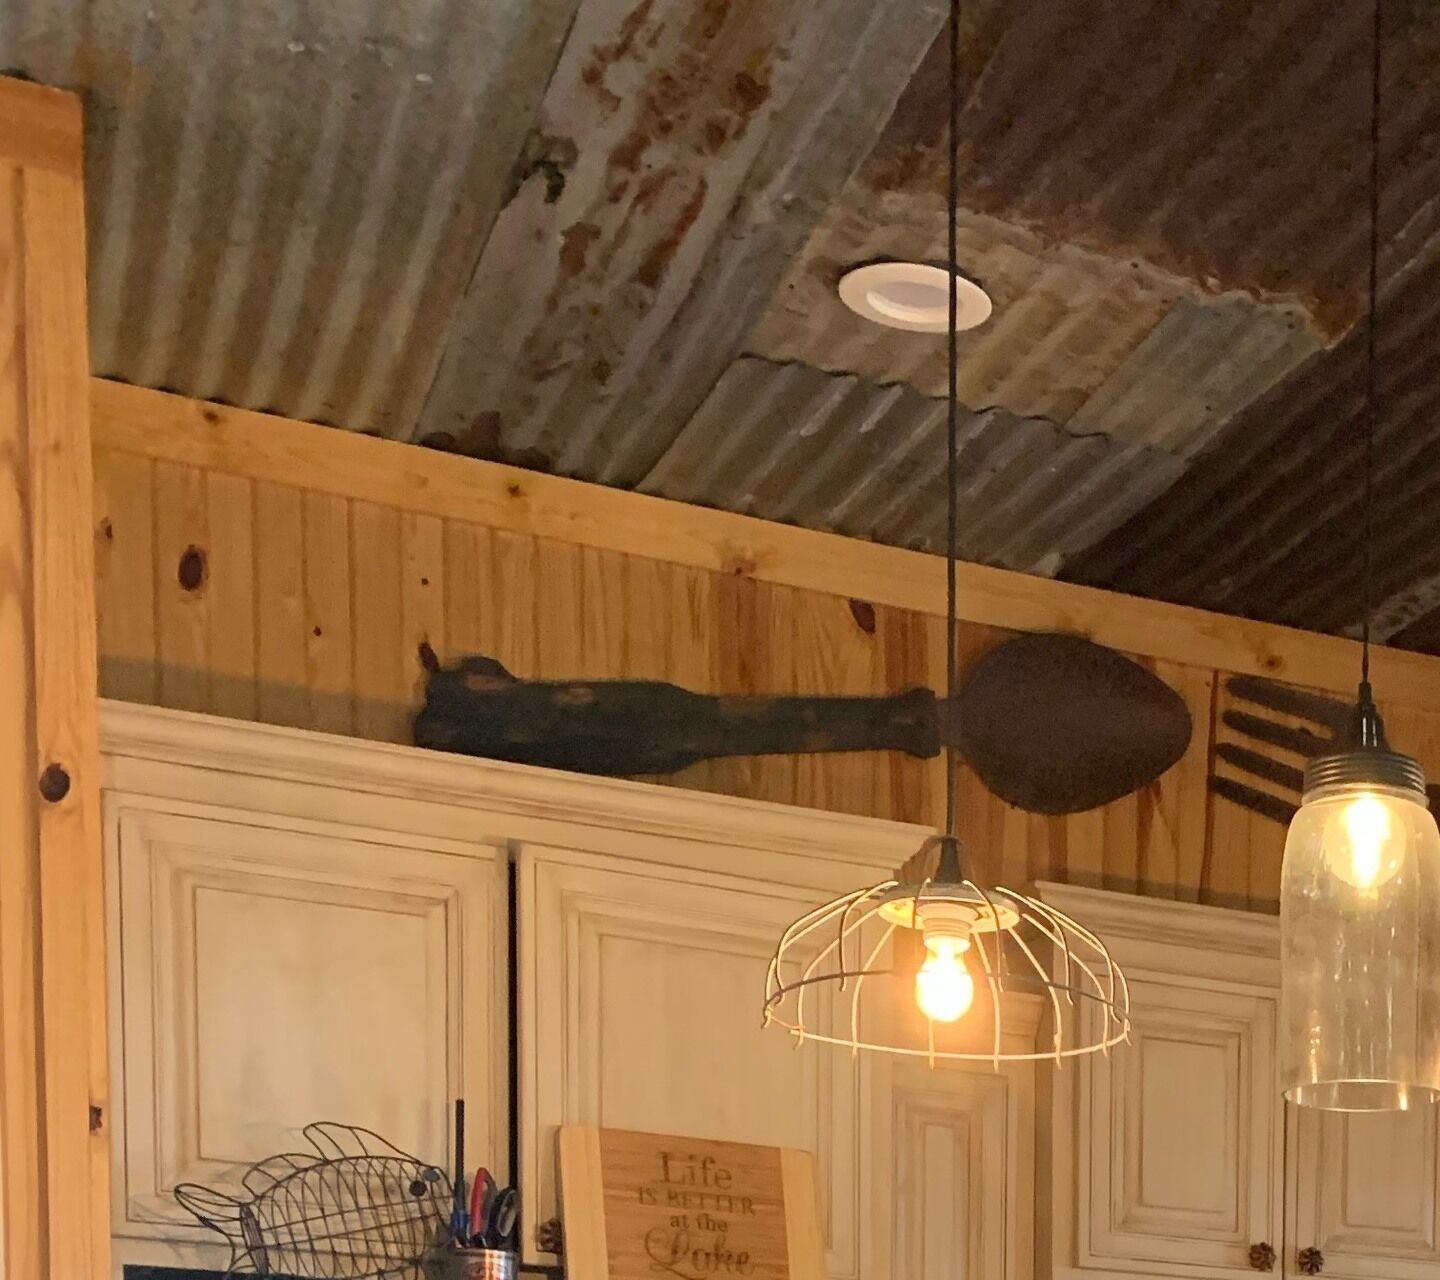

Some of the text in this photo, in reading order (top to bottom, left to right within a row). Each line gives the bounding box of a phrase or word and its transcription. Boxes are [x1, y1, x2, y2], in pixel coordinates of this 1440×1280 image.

[659, 1152, 733, 1189] Life
[639, 1186, 756, 1216] IS BETTER
[669, 1212, 729, 1233] at the
